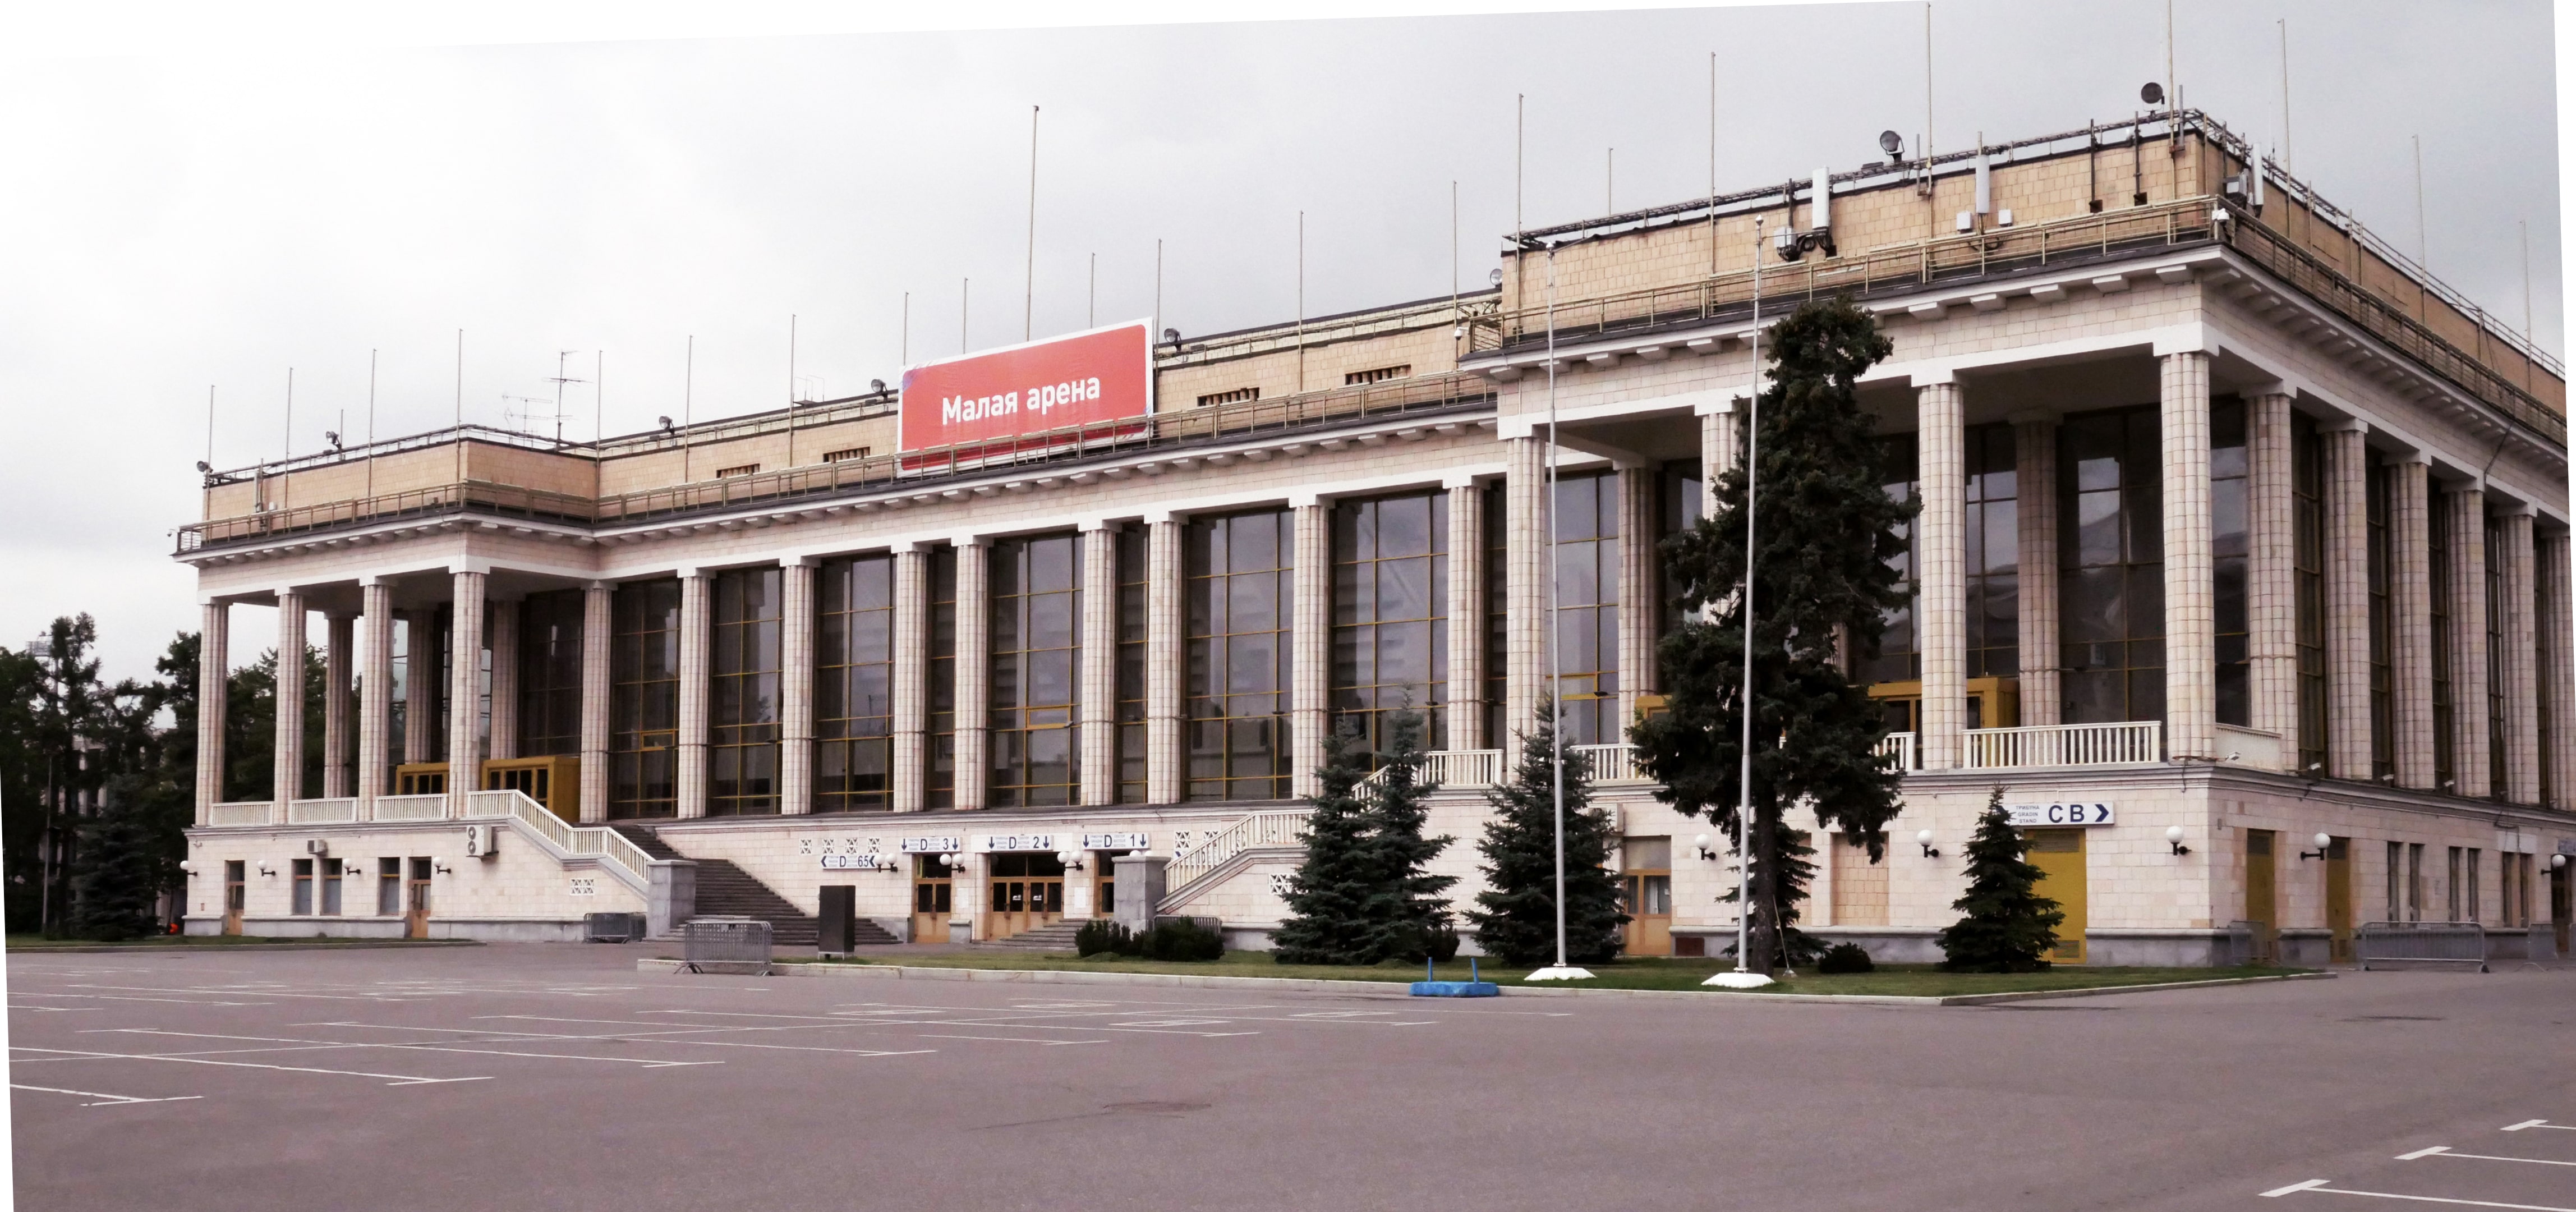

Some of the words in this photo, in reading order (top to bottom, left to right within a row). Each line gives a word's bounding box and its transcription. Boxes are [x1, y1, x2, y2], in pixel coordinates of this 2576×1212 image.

[942, 391, 1018, 425] Малая
[1026, 377, 1100, 415] арена
[921, 838, 927, 851] D
[943, 838, 949, 850] 3
[1009, 837, 1016, 849] D
[1033, 836, 1039, 848] 2
[1104, 834, 1112, 847] D
[1130, 834, 1134, 847] 1
[839, 855, 847, 867] D
